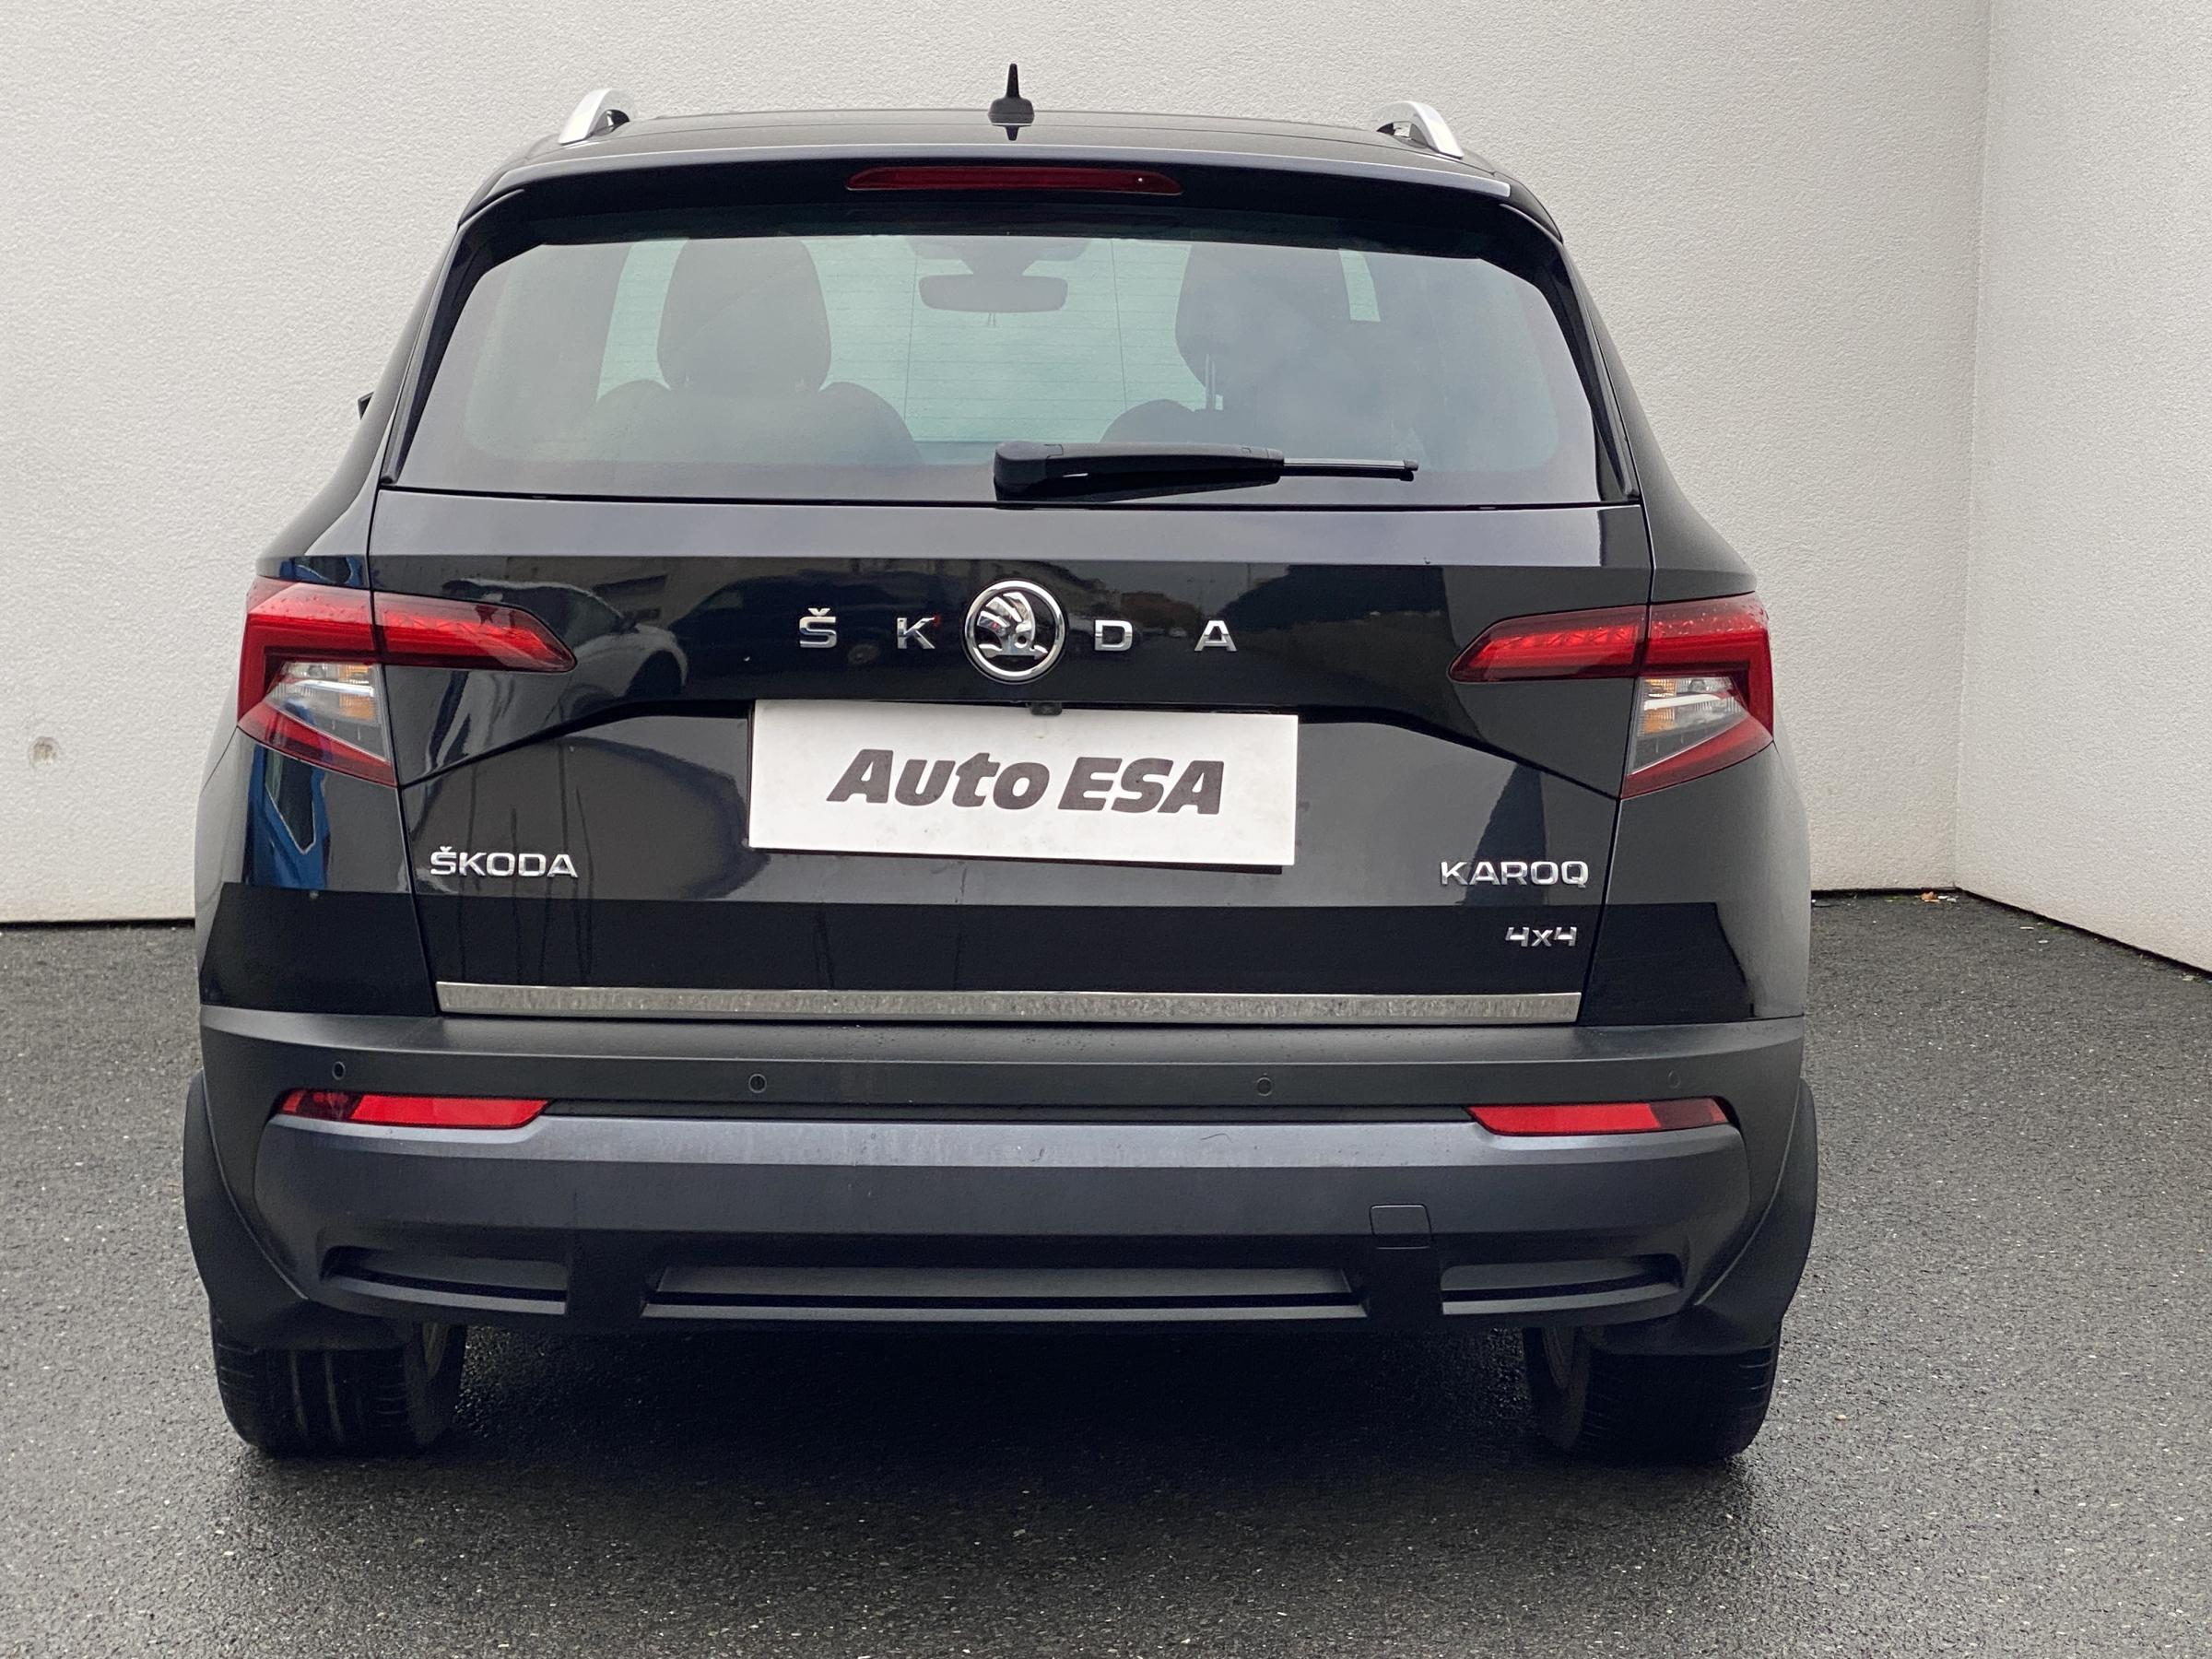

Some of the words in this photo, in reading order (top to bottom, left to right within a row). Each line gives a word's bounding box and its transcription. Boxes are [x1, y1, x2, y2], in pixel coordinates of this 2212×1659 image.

[826, 748, 1050, 810] Auto
[1057, 756, 1225, 816] ESA
[429, 845, 579, 878] ŠKODA
[1440, 861, 1590, 888] KAROQ
[1505, 926, 1578, 947] 4x4
